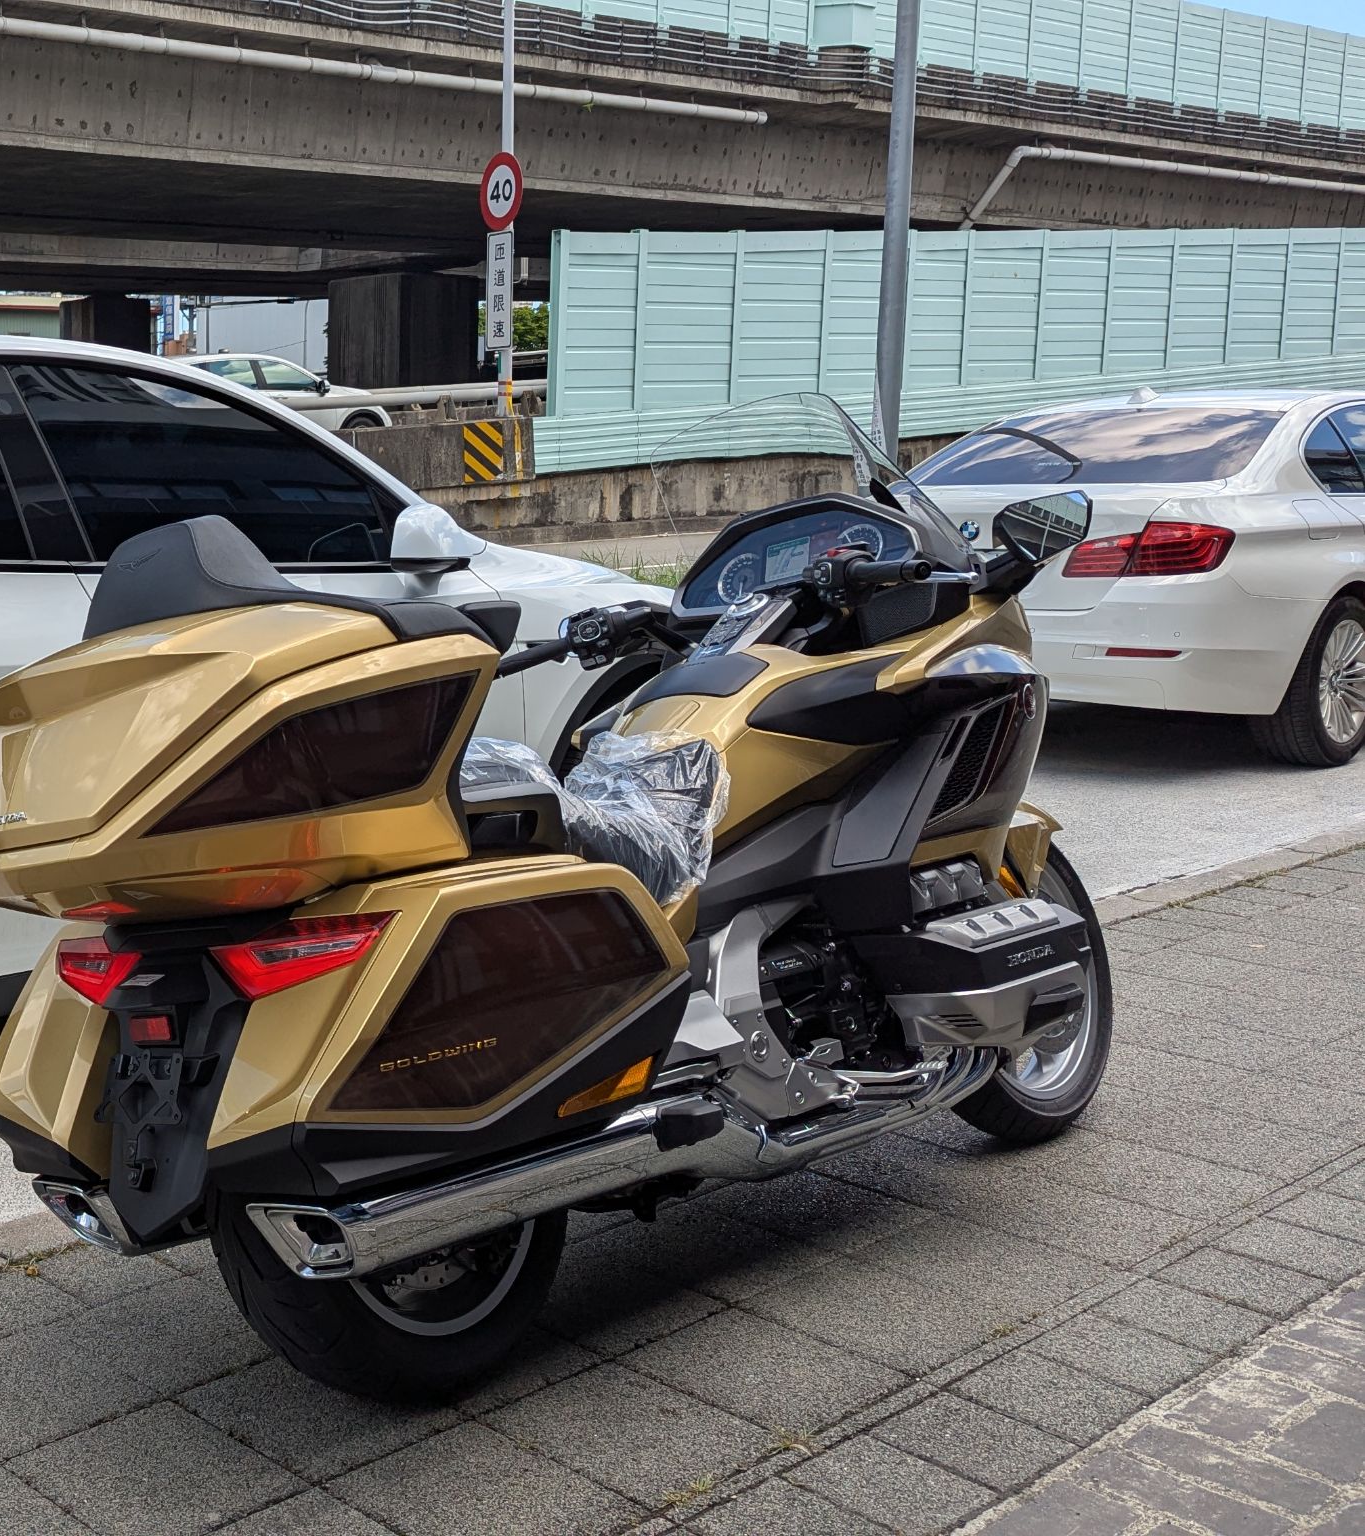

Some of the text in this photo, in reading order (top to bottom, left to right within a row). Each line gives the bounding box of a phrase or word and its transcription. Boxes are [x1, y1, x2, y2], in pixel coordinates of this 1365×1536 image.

[490, 179, 513, 204] 40
[493, 243, 506, 338] 匝道限速
[1006, 943, 1056, 968] HONDA
[379, 1037, 497, 1073] GOLDWING
